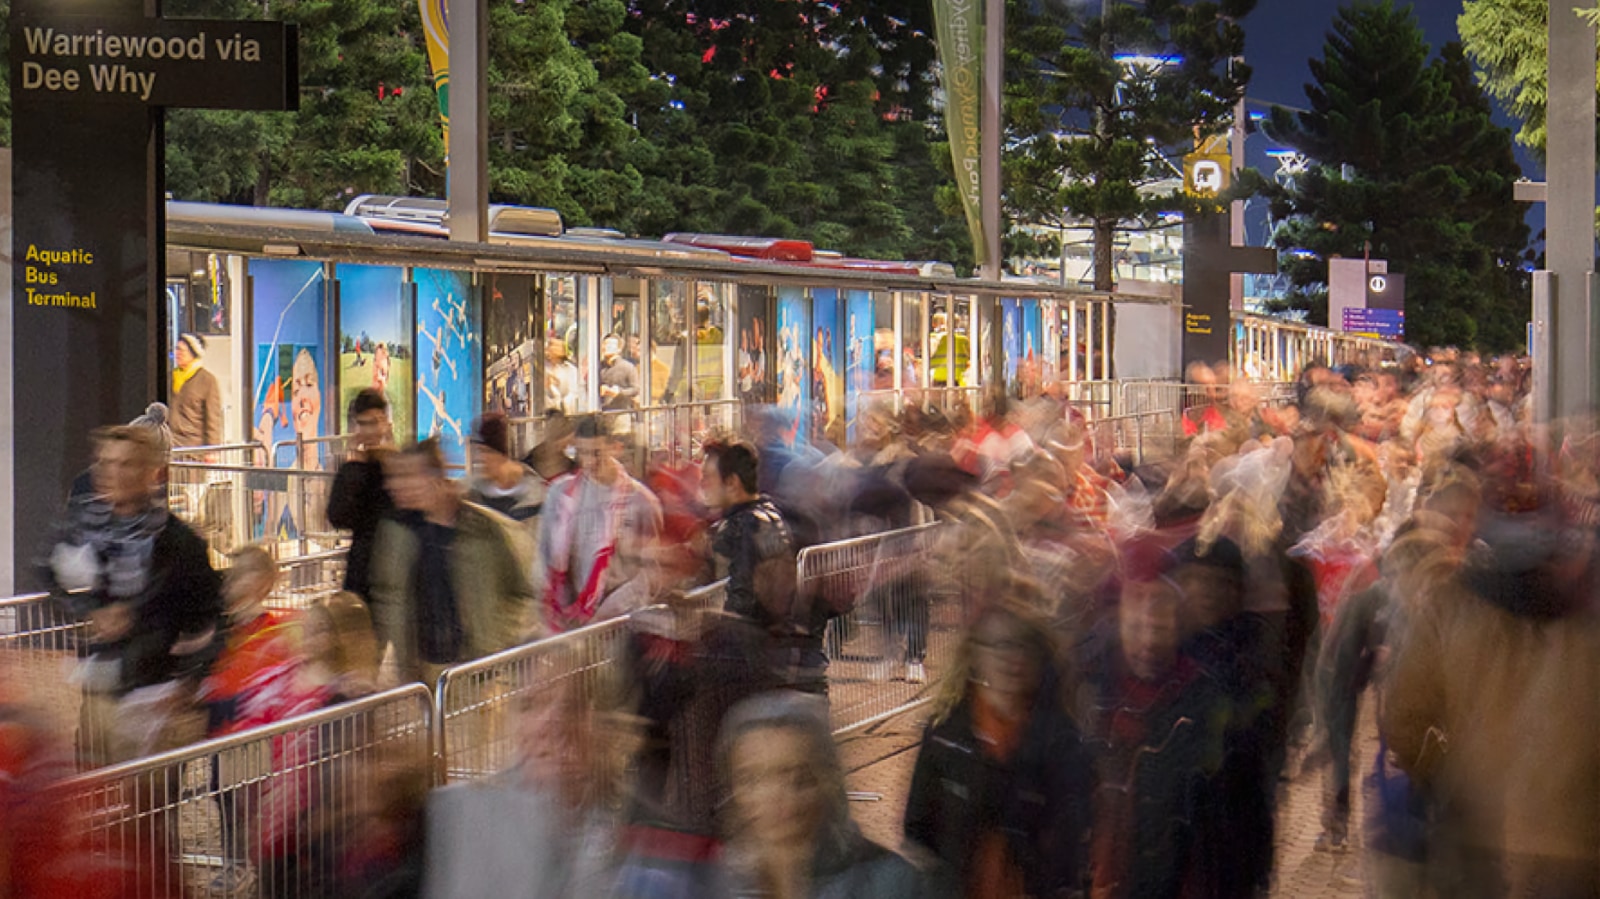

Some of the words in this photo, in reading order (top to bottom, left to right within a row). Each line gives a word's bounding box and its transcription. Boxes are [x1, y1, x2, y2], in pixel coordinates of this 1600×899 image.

[23, 26, 206, 60] Warriewood
[216, 33, 261, 62] via
[22, 61, 81, 91] Dee
[89, 64, 156, 101] Why
[25, 244, 94, 265] Aquatic
[25, 266, 58, 285] Bus
[25, 288, 97, 309] Terminal
